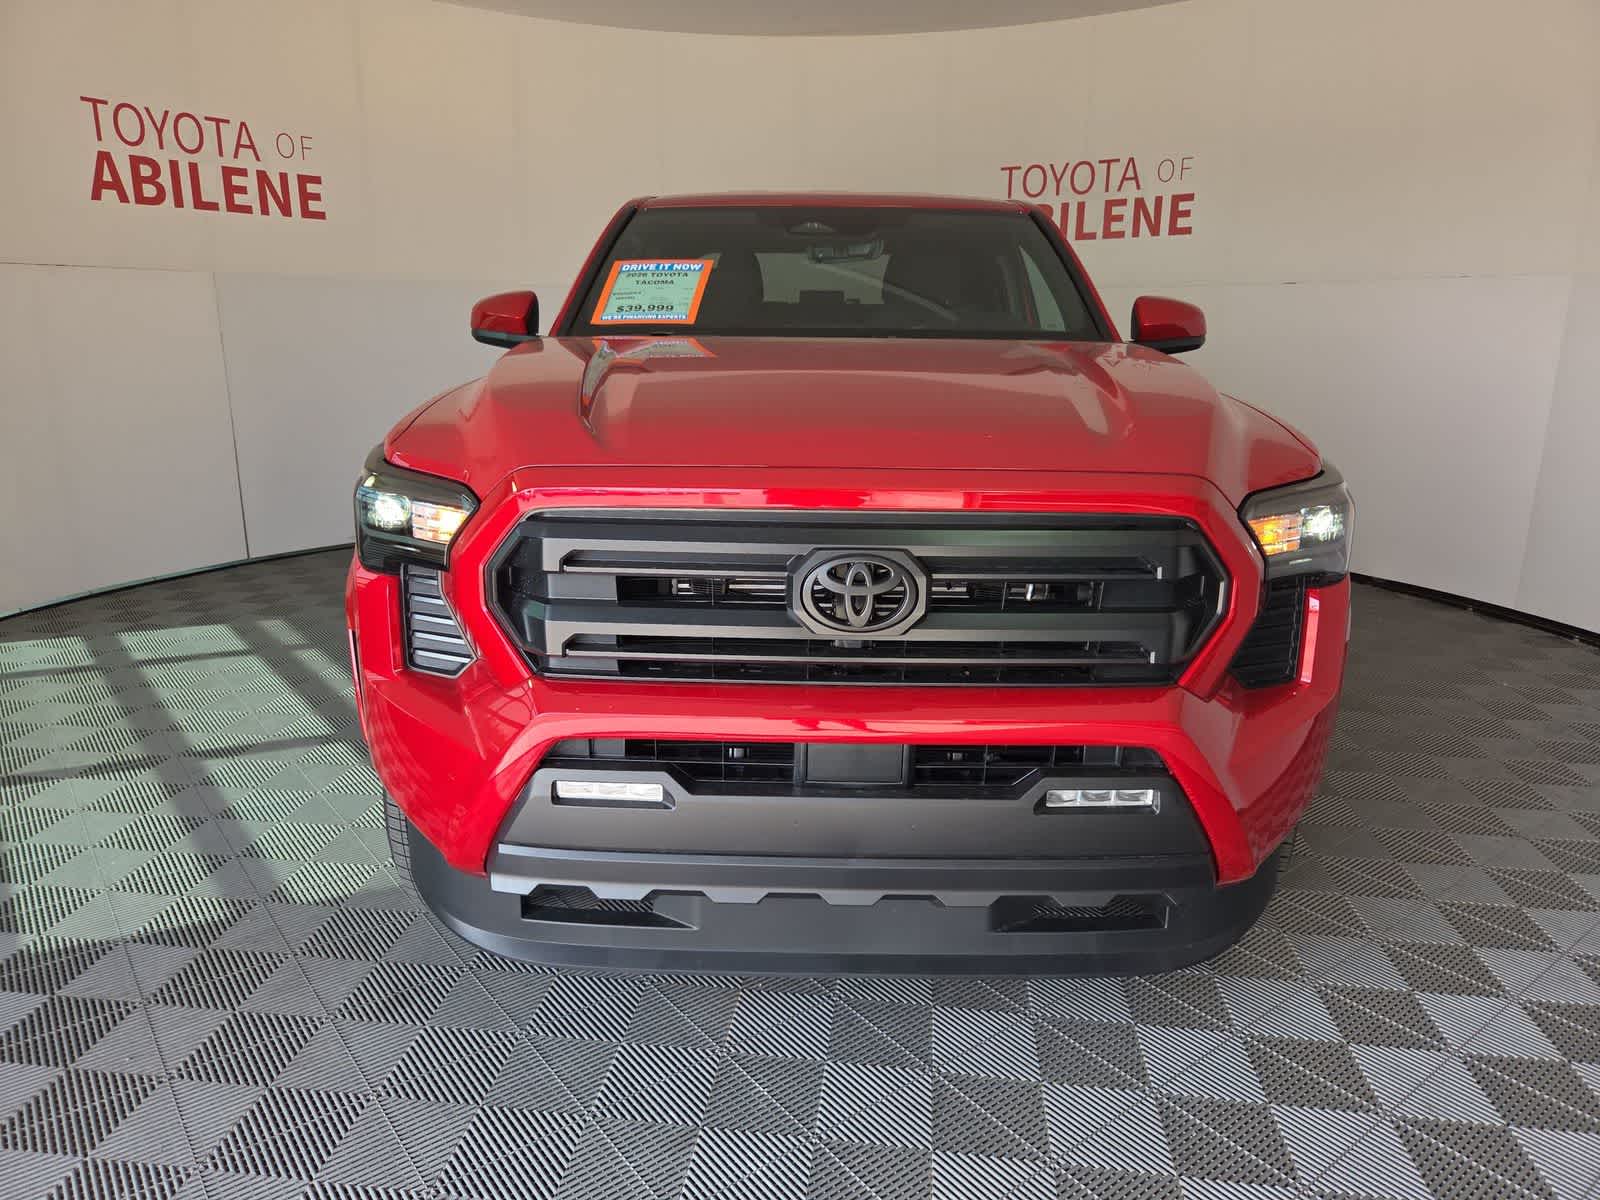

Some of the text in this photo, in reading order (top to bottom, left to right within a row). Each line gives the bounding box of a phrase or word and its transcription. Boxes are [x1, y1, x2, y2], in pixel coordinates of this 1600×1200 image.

[80, 96, 313, 162] TOYOTA OF
[90, 150, 327, 220] ABILENE
[1000, 156, 1194, 199] TOYOTA OF
[1034, 192, 1195, 241] ILENE
[621, 263, 703, 272] DRIVE IT NOW
